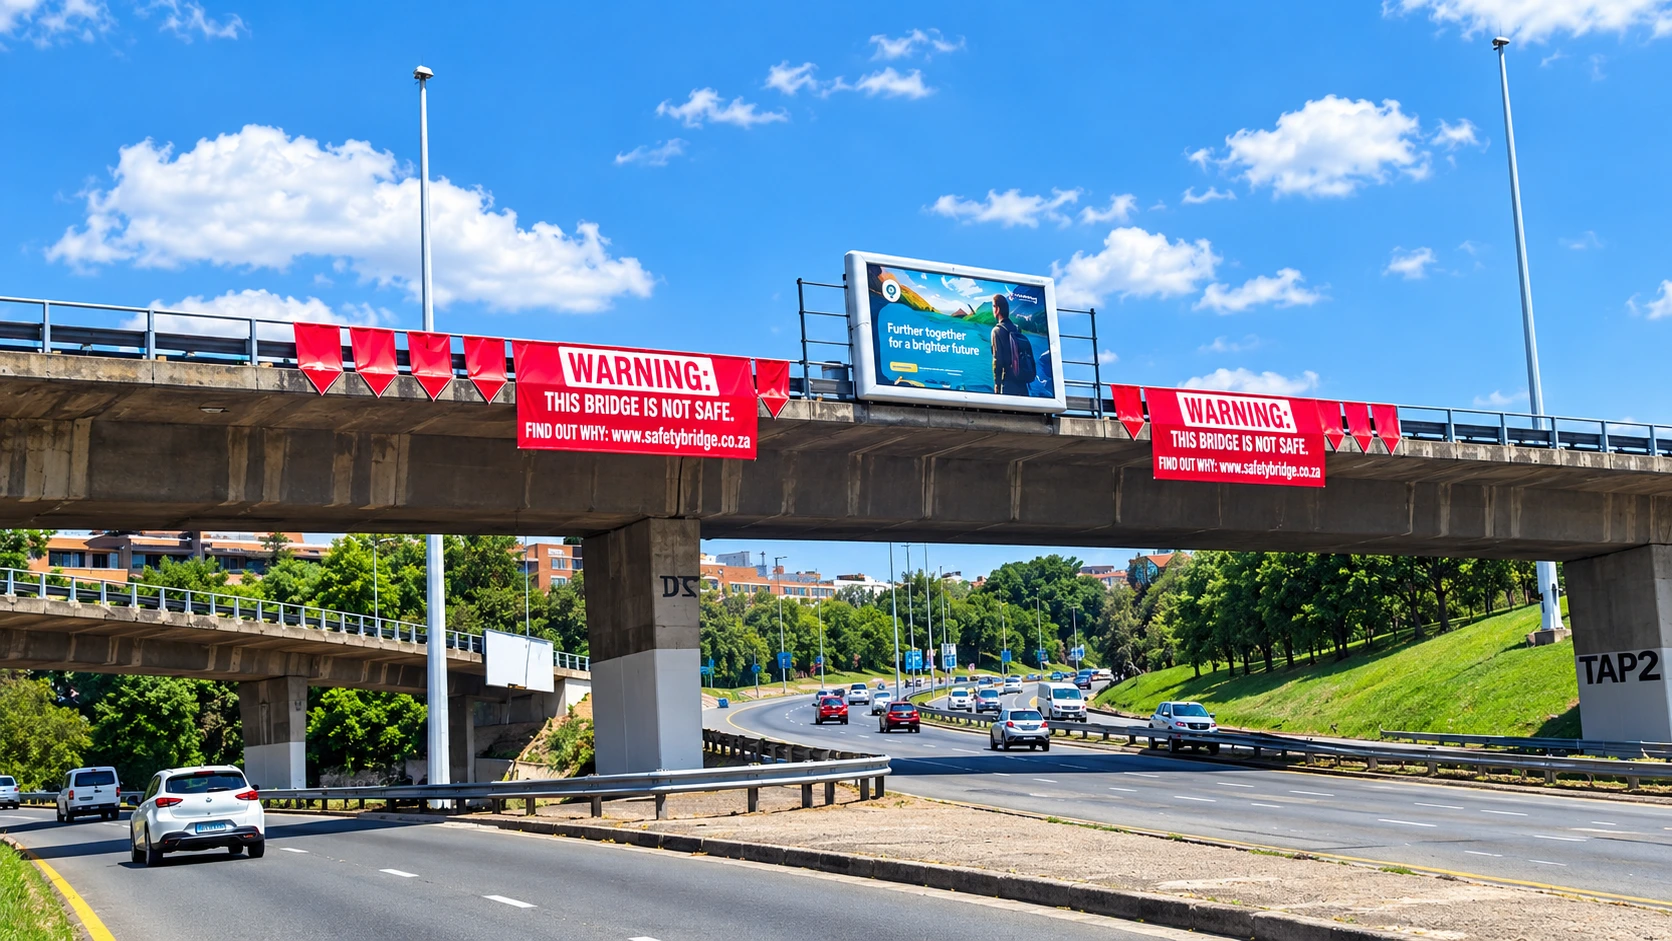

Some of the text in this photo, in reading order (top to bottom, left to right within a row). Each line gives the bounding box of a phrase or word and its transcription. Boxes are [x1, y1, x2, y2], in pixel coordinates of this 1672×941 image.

[887, 322, 967, 342] Further together
[888, 336, 980, 356] for a brighter future
[567, 352, 711, 391] WARNING:
[544, 391, 735, 422] THIS BRIDGE IS NOT SAFE.
[1183, 396, 1291, 429] WARNING:
[525, 421, 750, 451] FIND OUT WHY: www.safetybridge.co.za
[1170, 430, 1309, 455] THIS BRIDGE IS NOT SAFE.
[1158, 456, 1321, 481] FIND OUT WHY: www.safetybridge.co.za
[1579, 650, 1661, 685] TAP2
